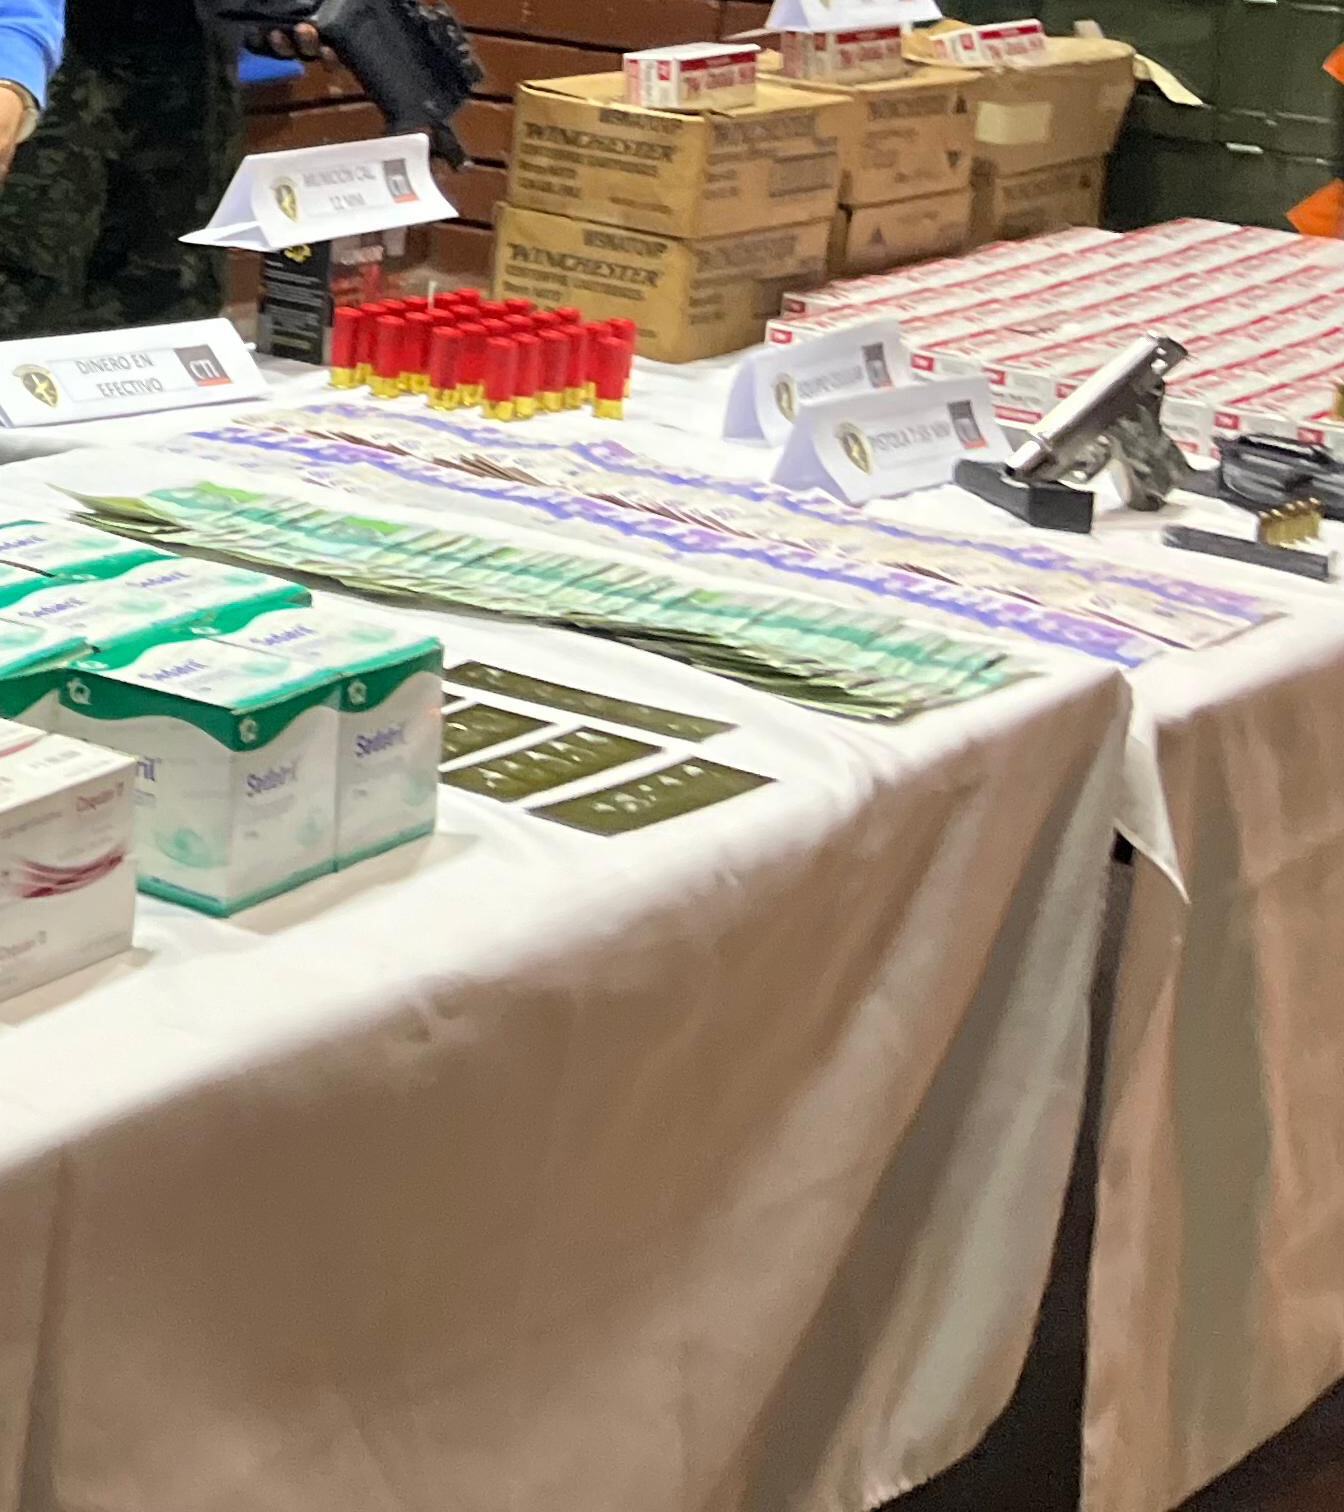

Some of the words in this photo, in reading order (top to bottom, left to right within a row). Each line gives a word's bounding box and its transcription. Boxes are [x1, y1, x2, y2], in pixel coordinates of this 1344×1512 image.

[75, 354, 132, 376] DINERO
[133, 352, 155, 369] EN
[95, 376, 164, 399] EFECTIVO
